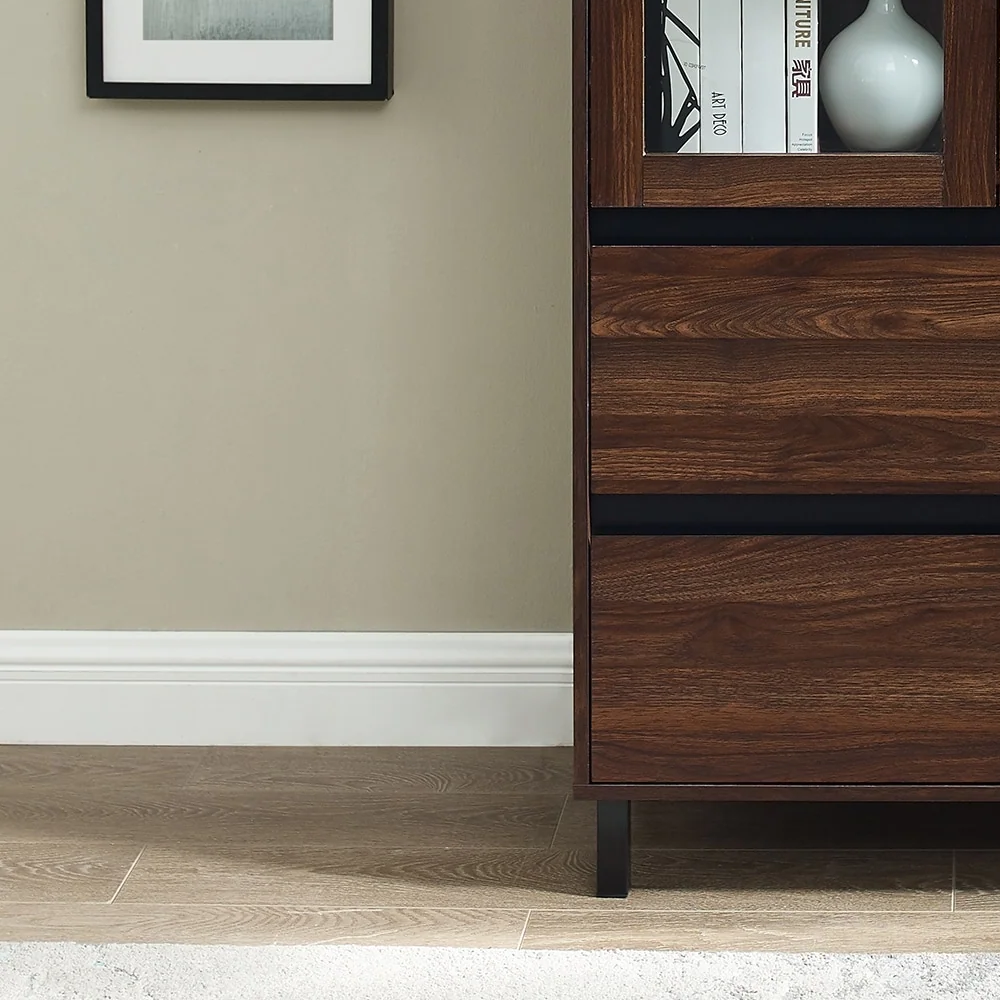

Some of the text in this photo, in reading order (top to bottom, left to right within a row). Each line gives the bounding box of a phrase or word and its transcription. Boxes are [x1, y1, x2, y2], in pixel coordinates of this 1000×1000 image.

[791, 59, 813, 98] 家具
[711, 91, 728, 136] ART DECO
